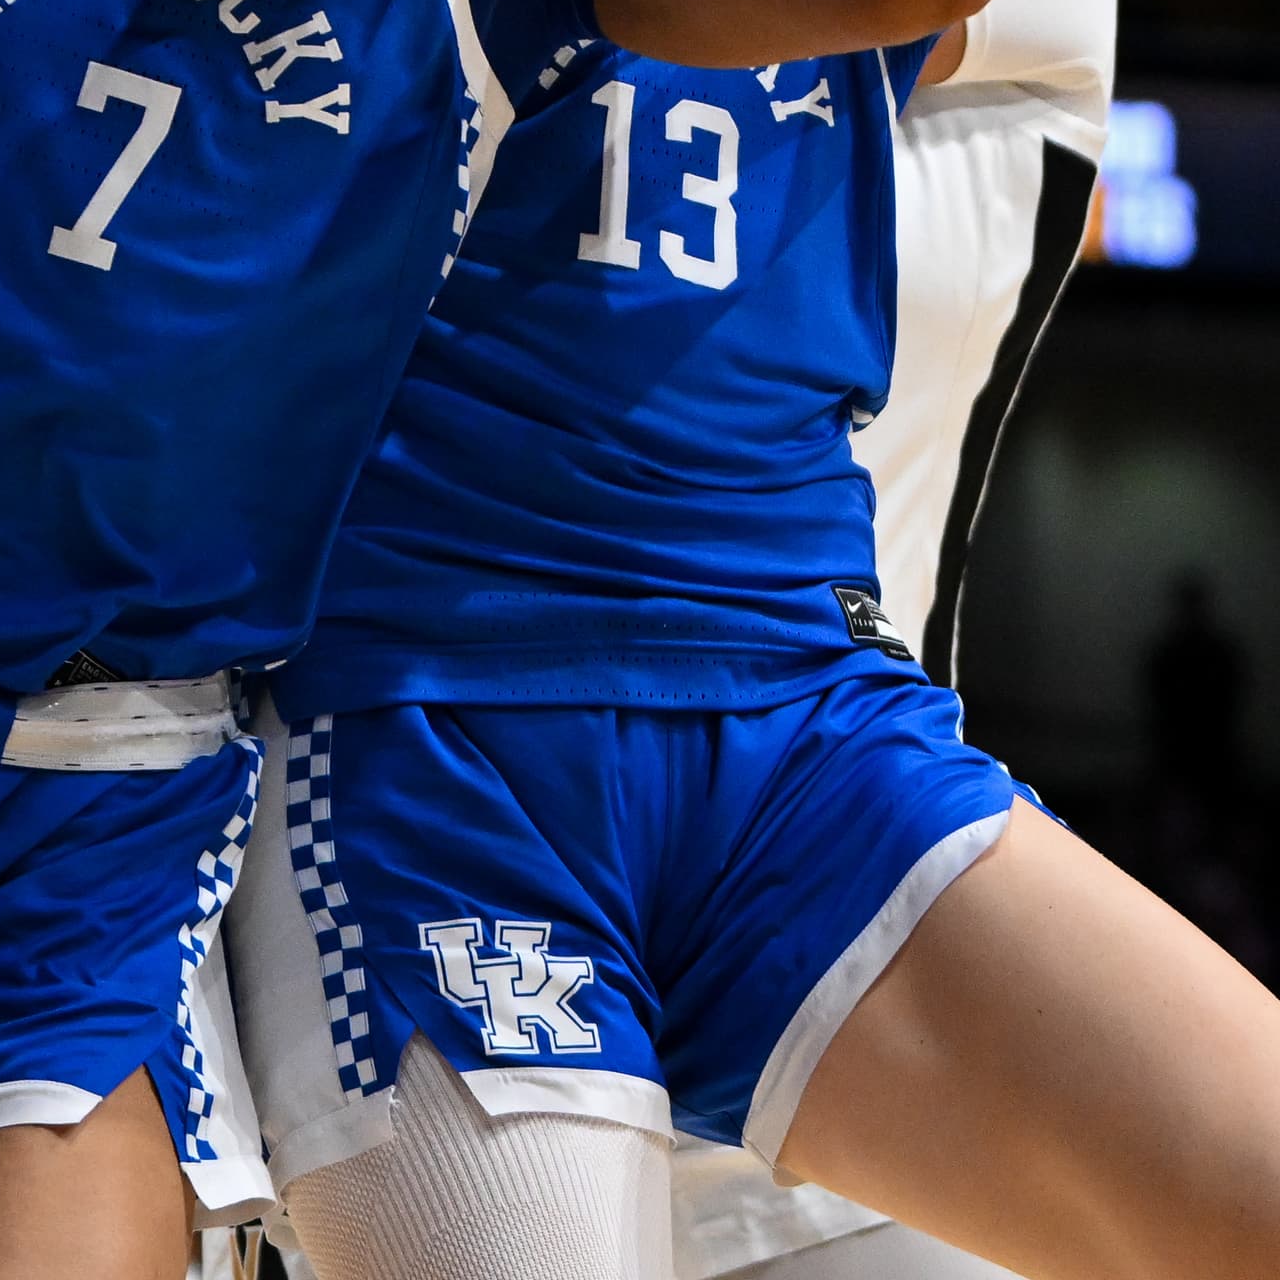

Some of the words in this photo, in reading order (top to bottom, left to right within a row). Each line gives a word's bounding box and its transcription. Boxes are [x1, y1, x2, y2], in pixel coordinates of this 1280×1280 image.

[48, 61, 182, 271] 7
[577, 80, 740, 290] 13
[418, 917, 601, 1056] UK
